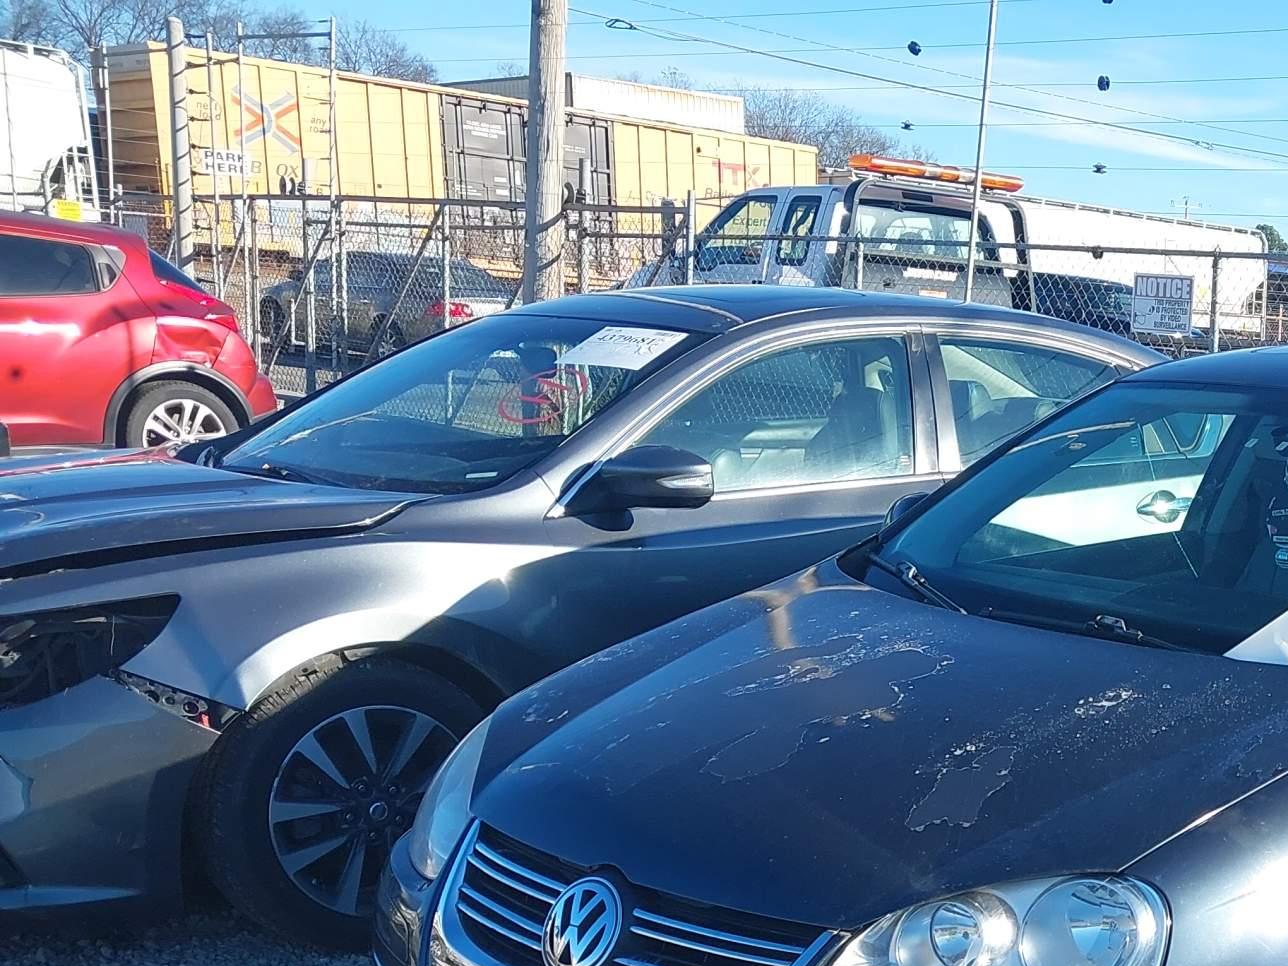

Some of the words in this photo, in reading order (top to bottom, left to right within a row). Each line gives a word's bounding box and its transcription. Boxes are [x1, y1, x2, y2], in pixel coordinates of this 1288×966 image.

[310, 117, 327, 128] any
[204, 151, 244, 162] PARK
[712, 160, 761, 188] TTX
[1136, 277, 1191, 298] NOTICE
[1165, 300, 1189, 308] PROPERTY
[1161, 307, 1188, 315] PROTECTED
[1168, 314, 1182, 322] VIDEO
[1153, 320, 1187, 330] SURVEILLANCE
